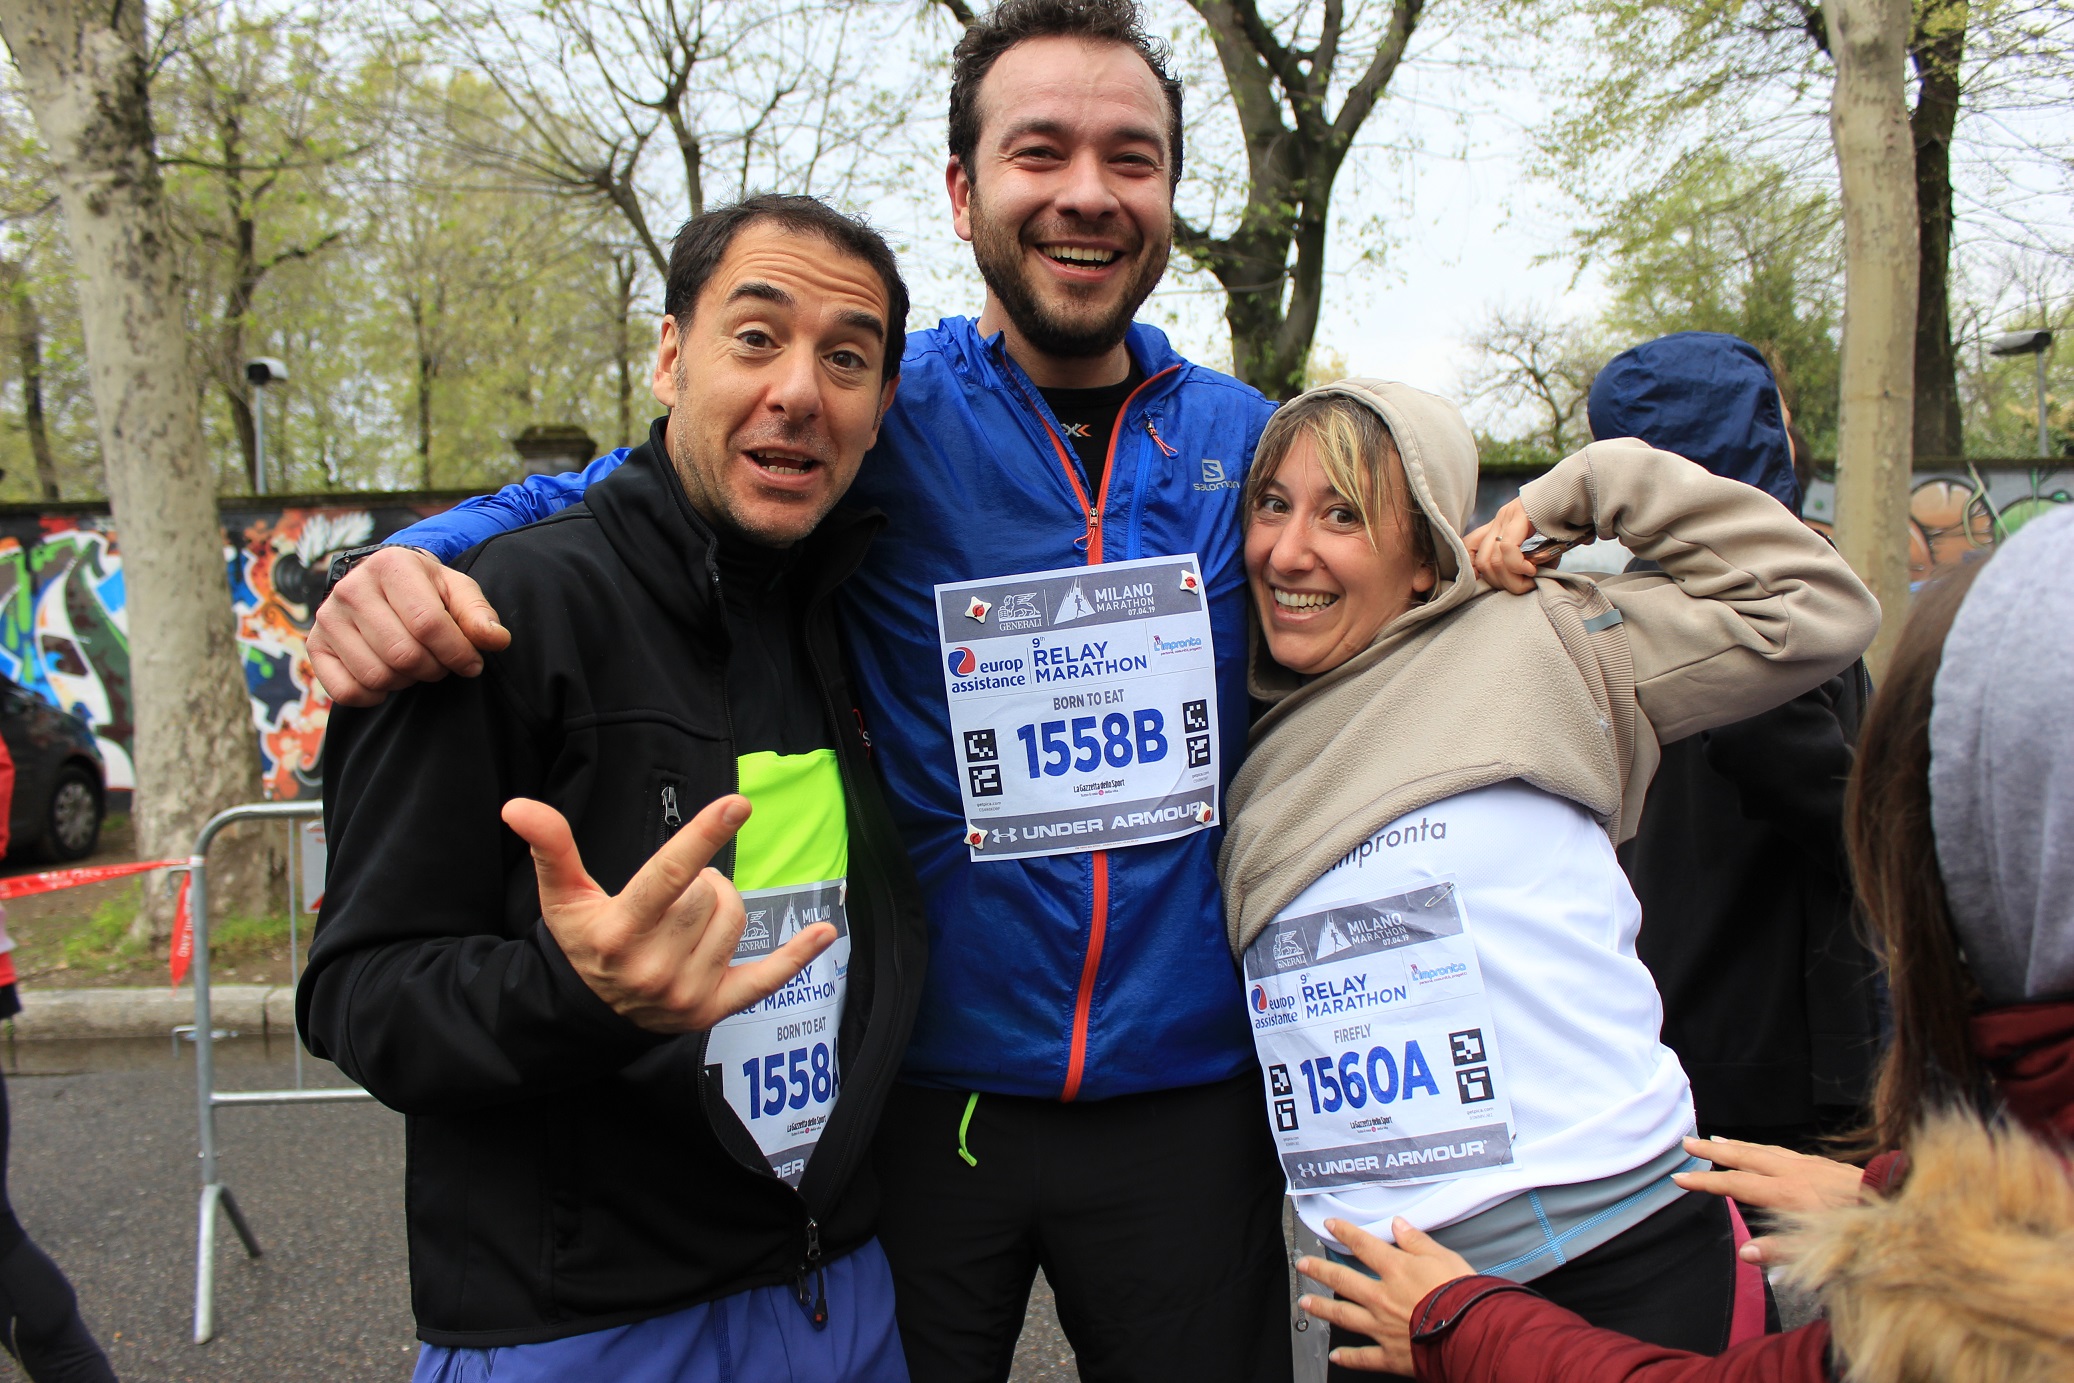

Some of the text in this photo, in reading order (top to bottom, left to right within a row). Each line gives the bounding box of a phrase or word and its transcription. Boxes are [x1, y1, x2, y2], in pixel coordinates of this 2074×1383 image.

[1095, 583, 1153, 602] MILANO
[1097, 596, 1155, 612] MARATHON
[1128, 606, 1155, 615] 07.04.19
[999, 619, 1042, 632] GENERALI
[1033, 641, 1108, 667] RELAY
[980, 658, 1024, 674] europ
[1035, 655, 1148, 684] MARATHON
[951, 675, 1026, 694] assistance
[1053, 689, 1124, 710] BORN TO EAT
[1016, 708, 1168, 779] 1558B
[1022, 801, 1201, 840] UNDER ARMOUR
[802, 905, 830, 924] MILANO
[1347, 912, 1402, 936] MILANO
[1351, 925, 1408, 945] MARATHON
[1382, 934, 1410, 946] 07.04.19
[764, 981, 836, 1012] MARATHON
[1302, 973, 1367, 1003] RELAY
[1306, 985, 1407, 1019] MARATHON
[777, 1016, 827, 1042] BORN TO EAT
[1333, 1023, 1371, 1044] FIREFLY
[742, 1036, 840, 1120] 1558A
[1300, 1040, 1440, 1115] 1560A
[773, 1159, 805, 1178] DER
[1317, 1140, 1486, 1176] UNDER ARMOUR
